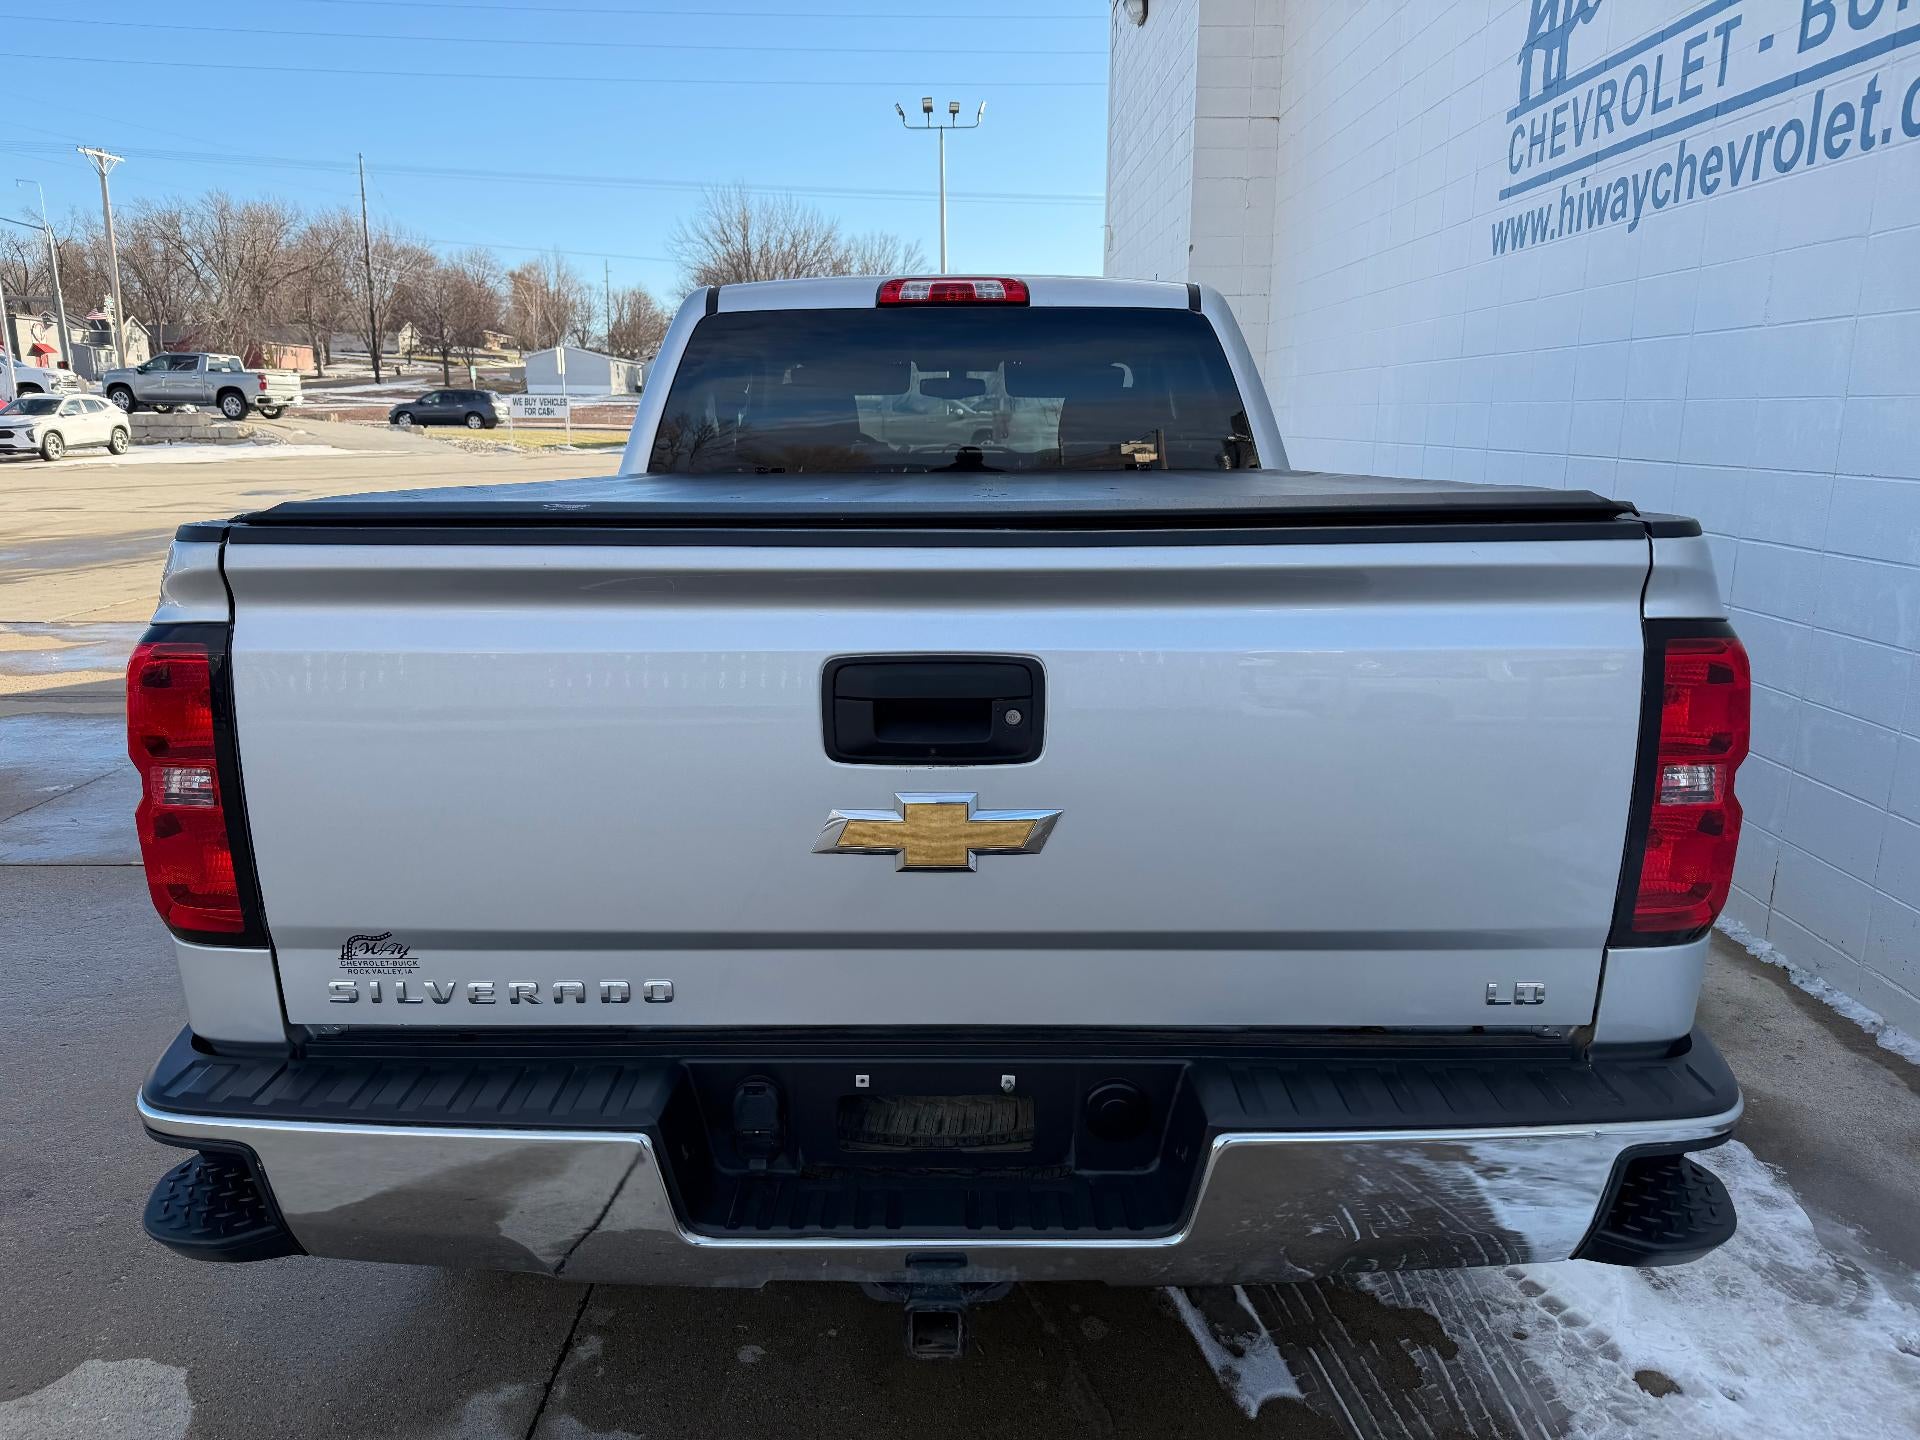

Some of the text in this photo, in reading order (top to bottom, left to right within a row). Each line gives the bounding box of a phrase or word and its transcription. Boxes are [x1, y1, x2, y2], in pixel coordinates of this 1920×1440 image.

[1508, 14, 1743, 175] CHEVROLET
[512, 397, 568, 407] WE BUY VEHICLES
[524, 407, 537, 416] FOR
[328, 980, 676, 1005] SILVERADO
[1486, 982, 1546, 1005] LD
